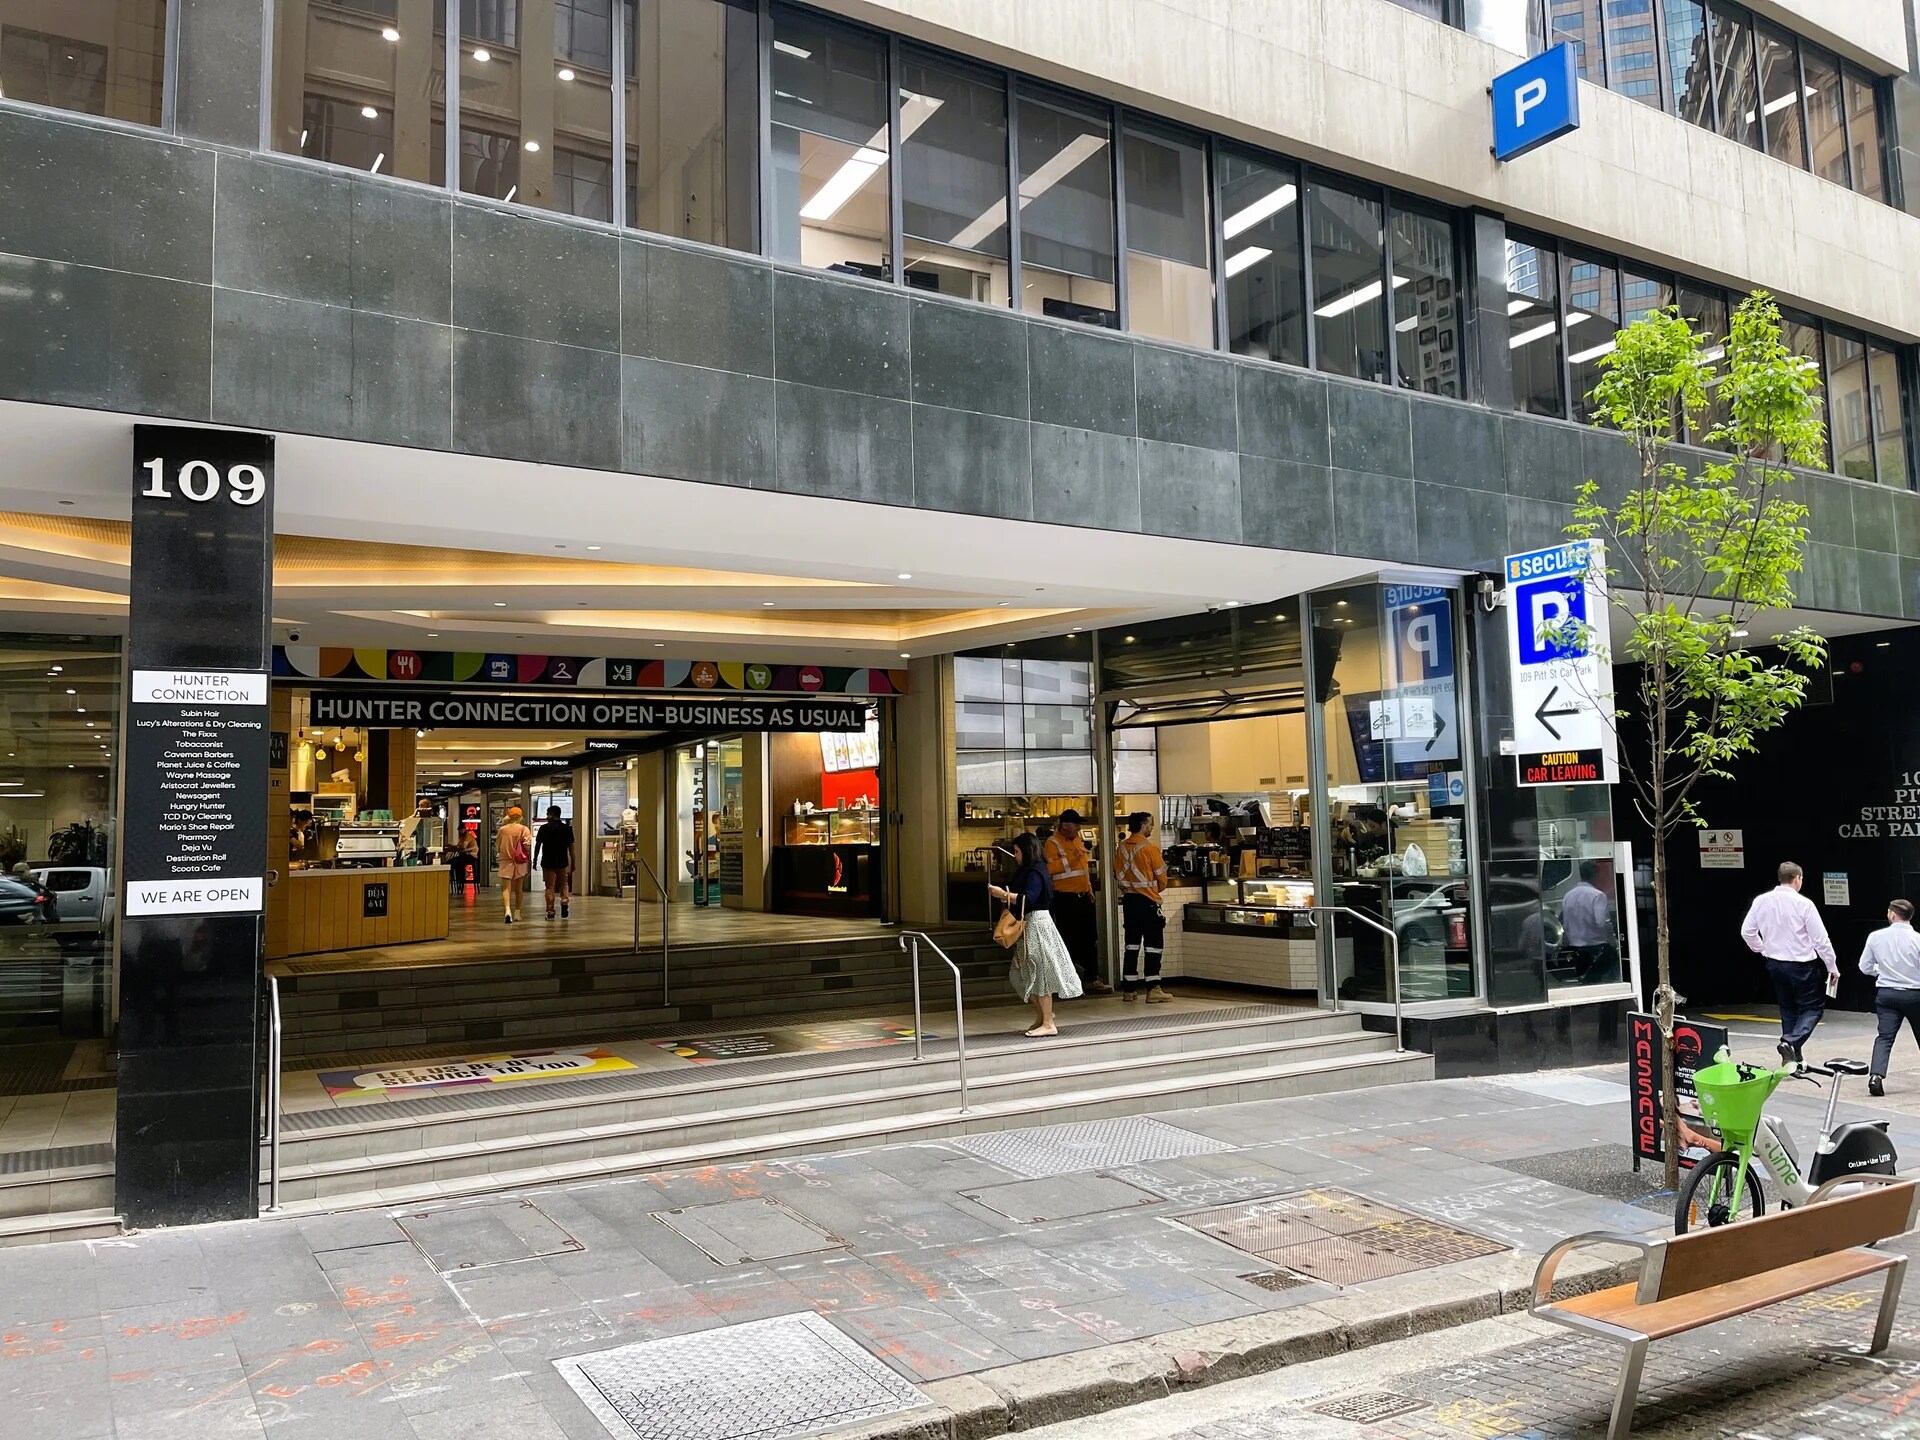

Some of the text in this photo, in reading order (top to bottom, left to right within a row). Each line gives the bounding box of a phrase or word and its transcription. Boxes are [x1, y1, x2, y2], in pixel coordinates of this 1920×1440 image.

[1515, 77, 1547, 128] P
[142, 457, 266, 505] 109
[1531, 590, 1570, 652] P
[1520, 665, 1592, 682] 109 Pitt St Car Park
[173, 674, 229, 687] HUNTER
[151, 689, 249, 702] CONNECTION
[180, 709, 220, 718] Subin Hair
[317, 699, 861, 728] HUNTER CONNECTION OPEN-BUSINESS AS USUAL
[136, 719, 262, 730] Lucy's Alterations & Dry Cleaning
[182, 730, 197, 738] The
[175, 740, 224, 748] Tobacconist
[589, 741, 619, 750] Pharmacy
[163, 750, 234, 759] Caveman Barbers
[1542, 752, 1579, 766] CAUTION
[156, 761, 241, 769] Planet Juice & Coffee
[166, 771, 231, 780] Wayne Massage
[1527, 764, 1597, 782] CAR LEAVING
[160, 781, 236, 790] Aristocrat Jewellers
[175, 792, 220, 801] Newsagent
[1894, 789, 1920, 804] PI
[170, 802, 226, 811] Hungry Hunter
[163, 812, 232, 821] TCD Dry Cleaning
[1861, 806, 1920, 821] STRE
[159, 822, 235, 832] Mario's Shoe Repair
[1838, 823, 1880, 838] CAR
[177, 833, 218, 842] Pharmacy
[181, 844, 213, 853] Deja Vu
[166, 853, 227, 863] Destination Roll
[171, 864, 222, 873] Scoota Cafe
[141, 888, 250, 904] WE ARE OPEN
[376, 1058, 541, 1080] LET US BE OF
[381, 1060, 581, 1087] SERVICE TO YOU
[1634, 1020, 1655, 1154] MASSAGE
[1768, 1144, 1798, 1186] Lime
[1848, 1161, 1857, 1169] On
[1856, 1160, 1867, 1168] Lime
[1878, 1153, 1891, 1164] Lime
